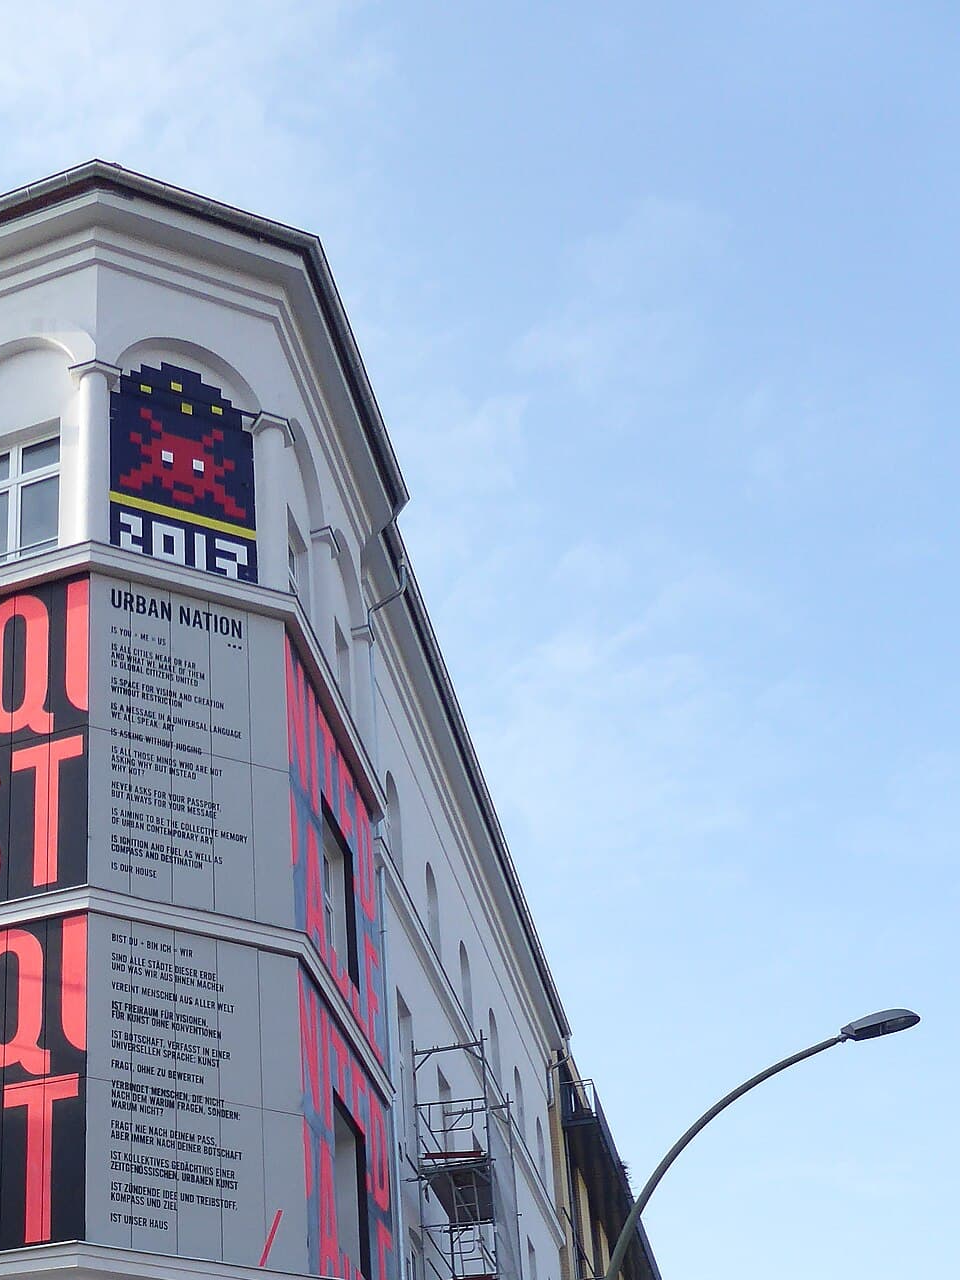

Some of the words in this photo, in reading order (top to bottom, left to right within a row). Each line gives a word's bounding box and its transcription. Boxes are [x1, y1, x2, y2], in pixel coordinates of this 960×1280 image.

[111, 588, 172, 622] URBAN
[180, 605, 242, 640] NATION
[111, 677, 117, 686] IS
[120, 679, 139, 691] SPACE
[142, 684, 153, 694] FOR
[157, 687, 176, 699] VISION
[180, 692, 192, 703] AND
[112, 746, 118, 754] IS
[120, 747, 131, 757] ALL
[134, 750, 154, 762] THOSE
[157, 755, 176, 767] MINDS
[179, 760, 193, 771] WHO
[196, 764, 207, 774] ARE
[211, 767, 222, 777] NOT
[112, 754, 135, 767] ASKING
[138, 760, 152, 770] WHY
[155, 764, 166, 774] BUT
[112, 763, 126, 773] WHY
[135, 786, 152, 797] ASKS
[154, 790, 166, 800] FOR
[168, 793, 184, 804] YOUR
[112, 807, 118, 816] IS
[146, 815, 153, 824] TO
[156, 817, 164, 826] BE
[167, 819, 178, 829] THE
[181, 822, 218, 837] COLLECTIVE
[221, 831, 247, 844] MEMORY
[111, 843, 143, 857] COMPASS
[146, 851, 158, 861] AND
[161, 854, 203, 870] DESTINATION
[112, 834, 117, 843] IS
[120, 836, 148, 849] IGNITION
[151, 842, 164, 852] AND
[167, 845, 182, 856] FUEL
[184, 849, 192, 858] AS
[195, 851, 211, 862] WELL
[214, 855, 222, 865] AS
[112, 862, 117, 870] IS
[120, 863, 133, 874] OUR
[136, 867, 157, 878] HOUSE
[112, 934, 127, 944] BIST
[147, 941, 158, 951] BIN
[161, 944, 171, 954] ICH
[180, 947, 193, 958] WIR
[112, 952, 127, 963] SIND
[130, 956, 145, 967] ALLE
[148, 960, 173, 973] STÄDTE
[175, 965, 197, 978] DIESER
[200, 970, 216, 981] ERDE
[112, 962, 125, 972] UND
[128, 965, 143, 976] WAS
[145, 969, 157, 979] WIR
[160, 972, 173, 982] AUS
[197, 979, 224, 993] MACHEN
[112, 981, 139, 995] VEREINT
[142, 987, 177, 1002] MENSCHEN
[180, 995, 192, 1005] AUS
[195, 998, 215, 1010] ALLER
[218, 1002, 234, 1013] WELT
[112, 1001, 122, 1011] IST
[125, 1003, 158, 1018] FREIRAUM
[161, 1010, 173, 1021] FÜR
[112, 1010, 124, 1020] FÜR
[127, 1013, 149, 1025] KUNST
[152, 1018, 169, 1029] OHNE
[172, 1022, 221, 1040] KONVENTIONEN
[112, 1030, 122, 1040] IST
[168, 1040, 200, 1055] VERFASST
[203, 1047, 210, 1056] IN
[112, 1040, 160, 1057] UNIVERSELLEN
[198, 1056, 220, 1068] KUNST
[137, 1064, 154, 1075] OHNE
[157, 1068, 165, 1077] ZU
[168, 1070, 204, 1085] BEWERTEN
[111, 1099, 137, 1112] WARUM
[112, 1080, 149, 1095] VERBINDET
[192, 1094, 202, 1104] DIE
[205, 1096, 224, 1108] NICHT
[112, 1089, 130, 1101] NACH
[133, 1093, 147, 1104] DEM
[150, 1096, 174, 1109] WARUM
[111, 1120, 132, 1131] FRAGT
[135, 1124, 146, 1134] NIE
[149, 1126, 167, 1137] NACH
[170, 1130, 195, 1142] DEINEM
[111, 1131, 129, 1142] ABER
[131, 1134, 154, 1146] IMMER
[156, 1138, 175, 1149] NACH
[177, 1141, 201, 1154] DEINER
[204, 1146, 242, 1160] BOTSCHAFT
[111, 1151, 121, 1160] IST
[124, 1153, 169, 1168] KOLLEKTIVES
[172, 1160, 213, 1175] GEDÄCHTNIS
[111, 1181, 122, 1191] IST
[124, 1183, 160, 1198] ZÜNDENDE
[163, 1190, 177, 1200] IDEE
[180, 1192, 194, 1203] UND
[182, 1172, 213, 1186] URBANEN
[216, 1178, 238, 1190] KUNST
[111, 1192, 144, 1206] KOMPASS
[147, 1198, 161, 1208] UND
[164, 1200, 177, 1211] ZIEL
[111, 1213, 121, 1223] IST
[124, 1215, 147, 1227] UNSER
[150, 1219, 168, 1230] HAUS
